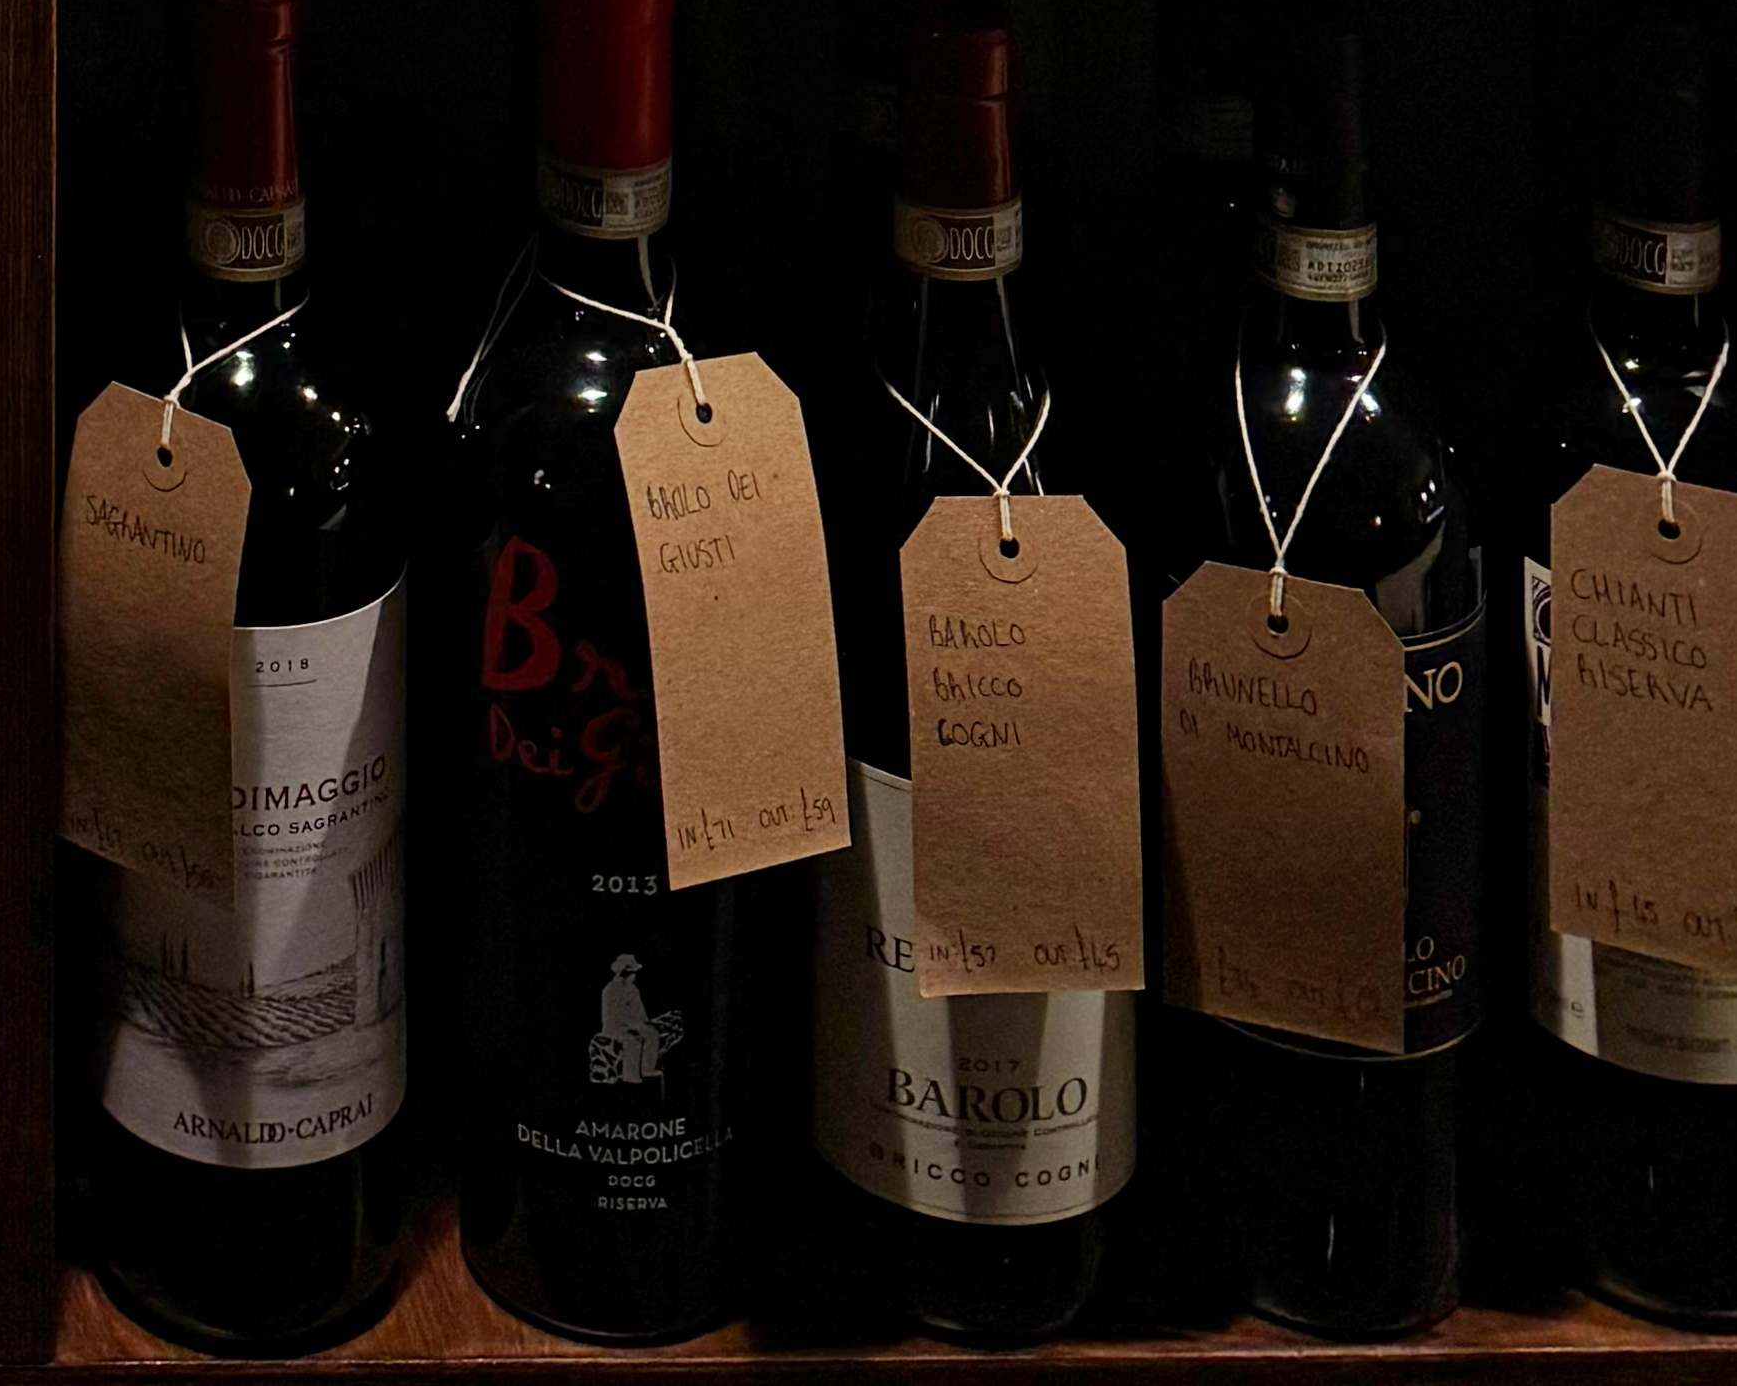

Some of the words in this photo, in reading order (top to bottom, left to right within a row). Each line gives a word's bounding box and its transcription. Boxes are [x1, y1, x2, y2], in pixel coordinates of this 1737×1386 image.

[728, 468, 761, 502] DEI
[85, 493, 206, 565] SAGRANTINO
[659, 534, 736, 575] GIUSTI
[1570, 568, 1697, 628] CHIANTI
[929, 613, 1027, 652] BAROLO
[1572, 614, 1708, 669] CLASSICO
[254, 658, 311, 674] 2018
[1577, 653, 1713, 712] RISERVA
[933, 672, 1024, 703] BRICCO
[1188, 657, 1318, 717] BRUNELLO
[1180, 709, 1200, 738] DI
[1226, 721, 1370, 775] MONTALCINO
[591, 874, 659, 897] 2013
[887, 1066, 1089, 1125] BAROLO
[517, 1122, 583, 1160] DELLA
[587, 1126, 734, 1166] VALPOLICELLA
[574, 1117, 687, 1141] AMARONE
[607, 1174, 657, 1188] DOCG
[597, 1195, 669, 1211] RISERVA
